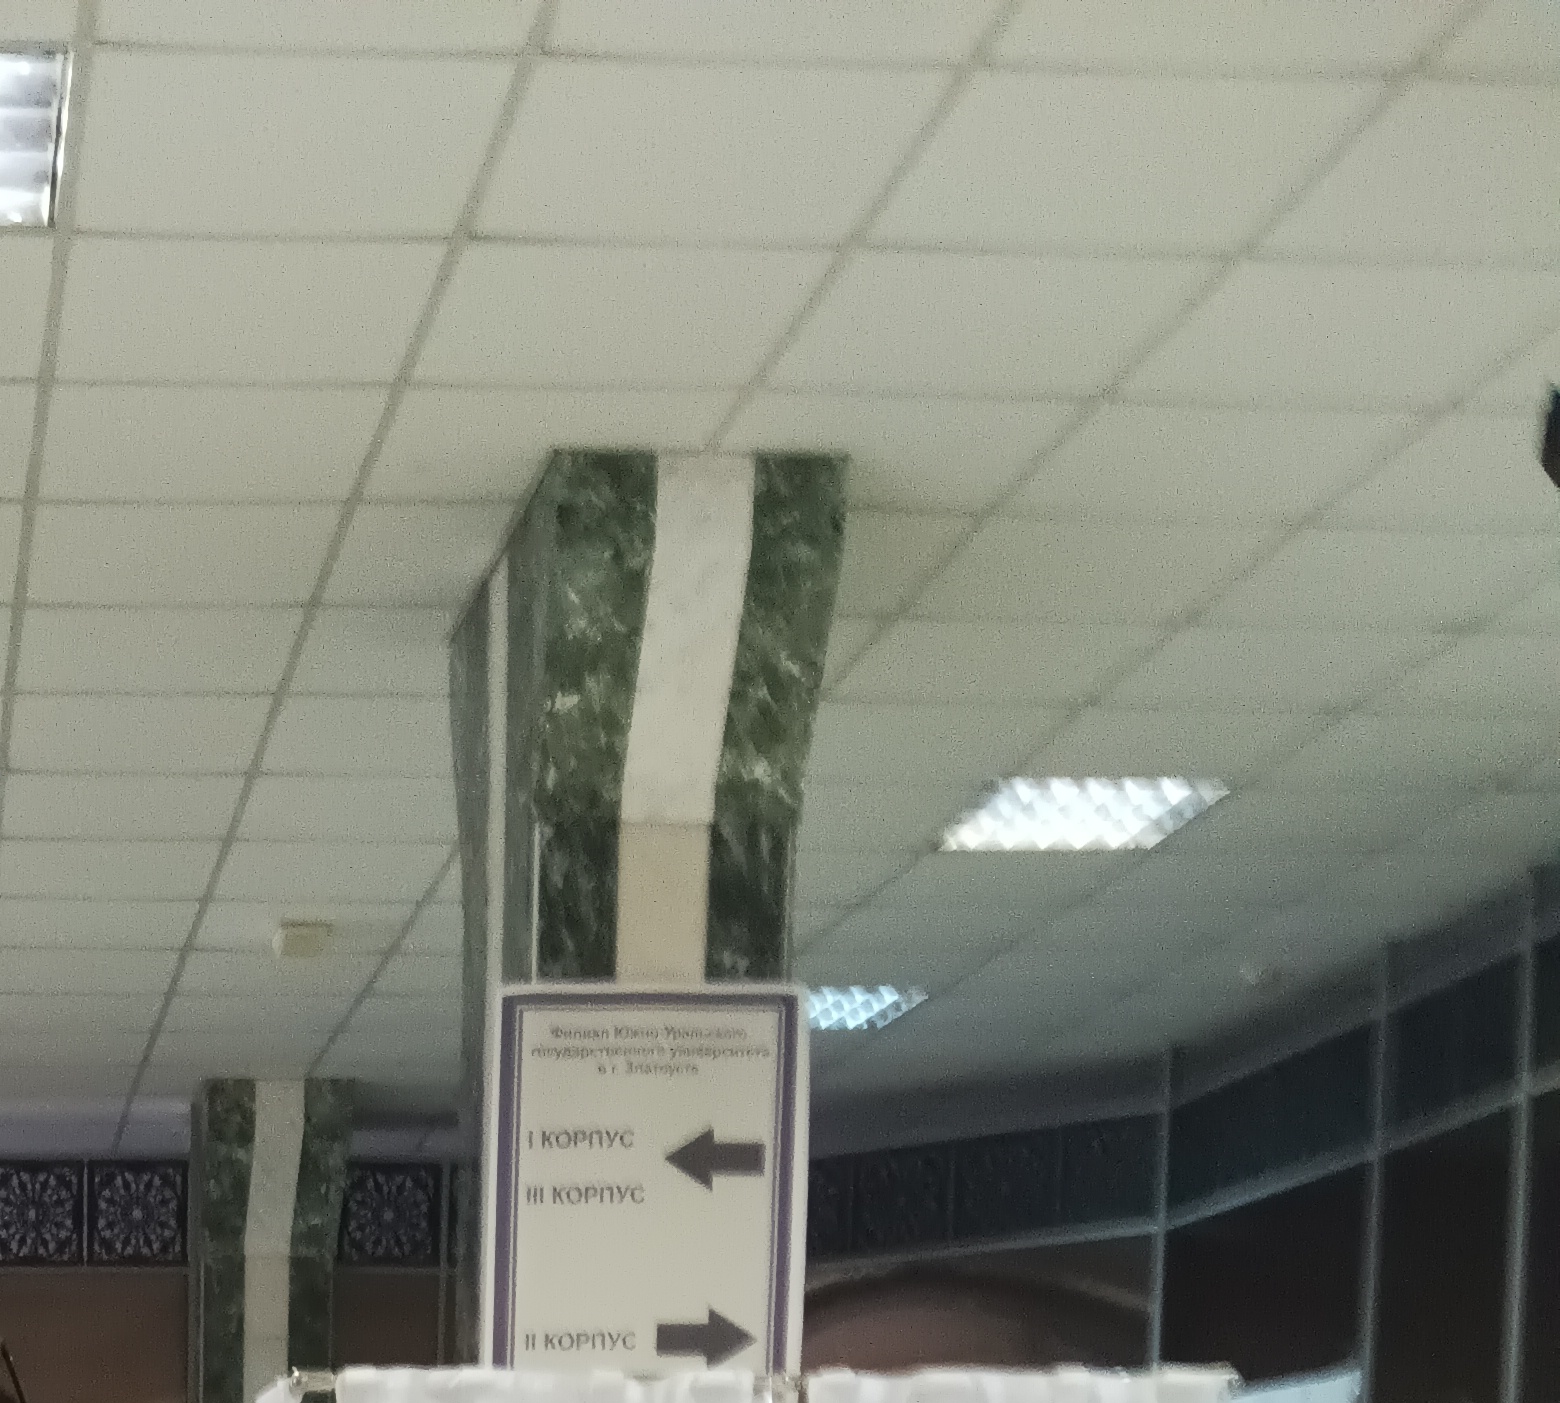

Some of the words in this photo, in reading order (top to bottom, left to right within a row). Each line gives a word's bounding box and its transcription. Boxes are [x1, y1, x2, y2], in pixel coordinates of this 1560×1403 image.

[541, 1129, 635, 1150] КОРПУС
[526, 1186, 545, 1205] III
[551, 1185, 645, 1205] КОРПУС
[525, 1333, 536, 1351] II
[544, 1332, 637, 1352] КОРПУС
